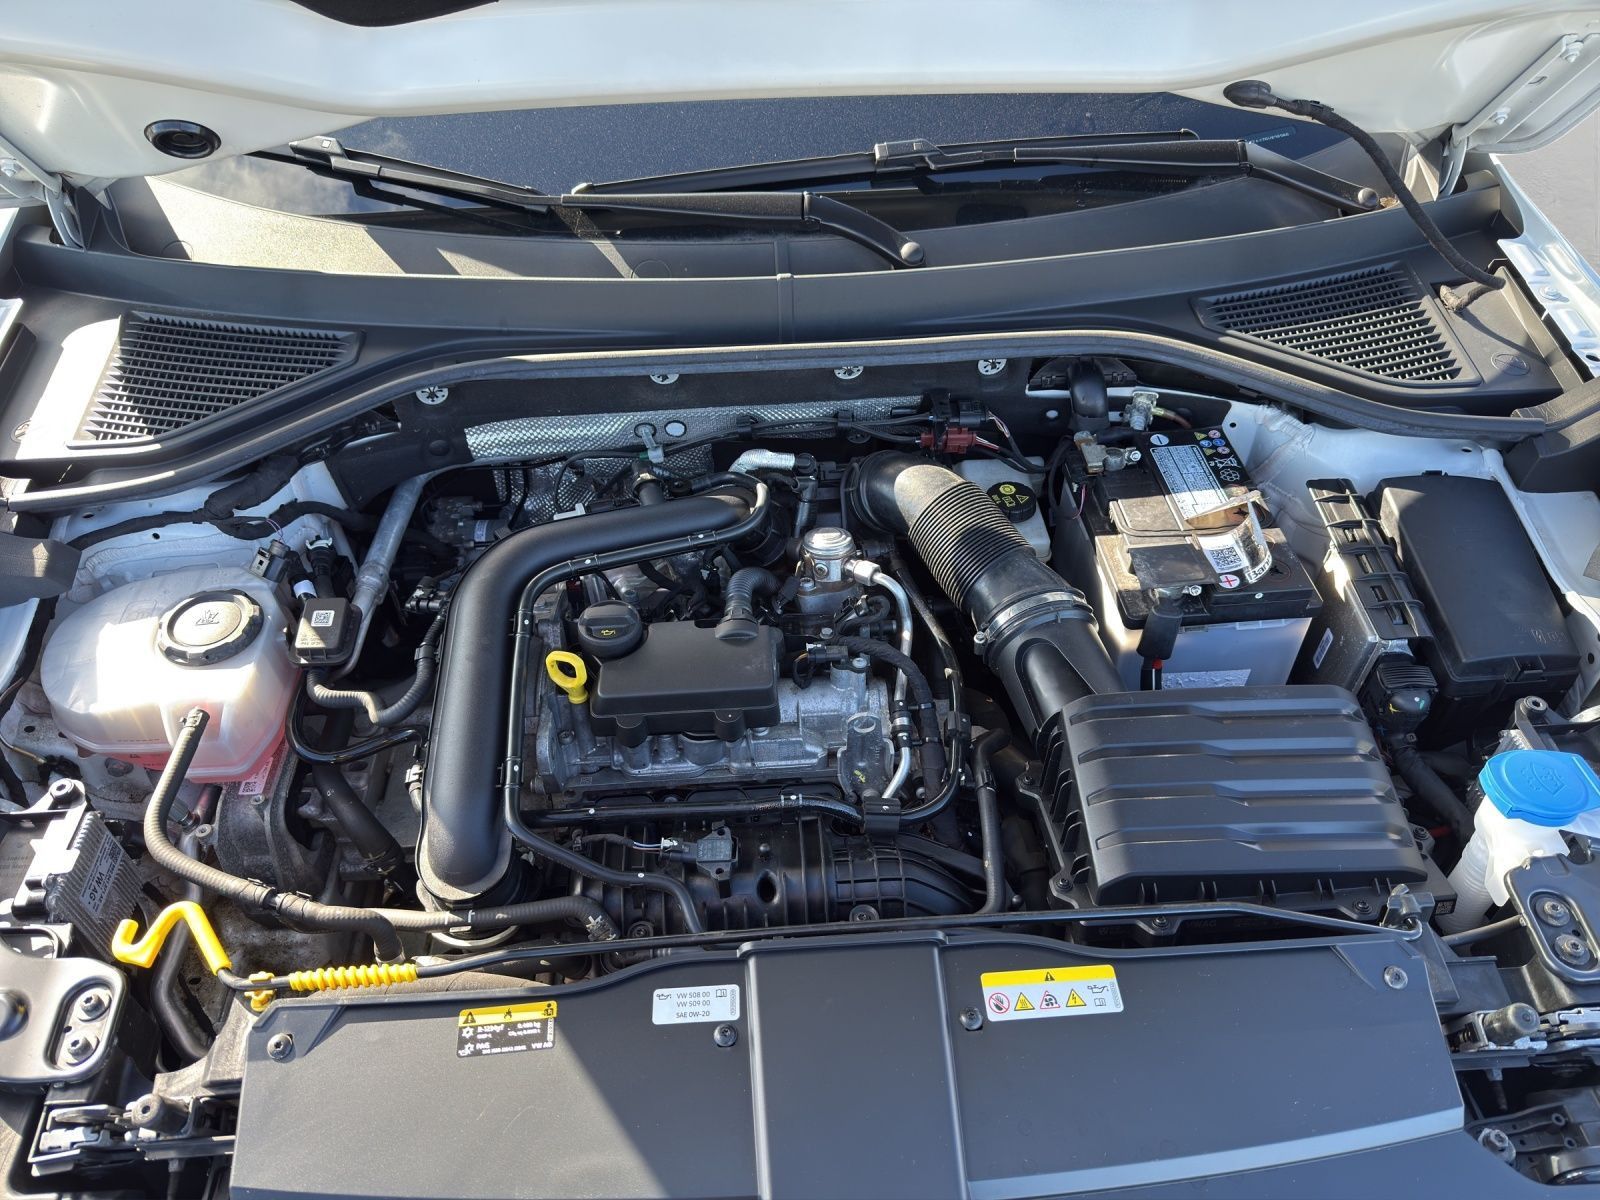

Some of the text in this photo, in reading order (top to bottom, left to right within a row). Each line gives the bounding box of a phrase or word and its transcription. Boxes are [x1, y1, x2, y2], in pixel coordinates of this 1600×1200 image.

[95, 871, 105, 886] VW
[89, 886, 98, 901] AG
[688, 1010, 711, 1018] 0W-20
